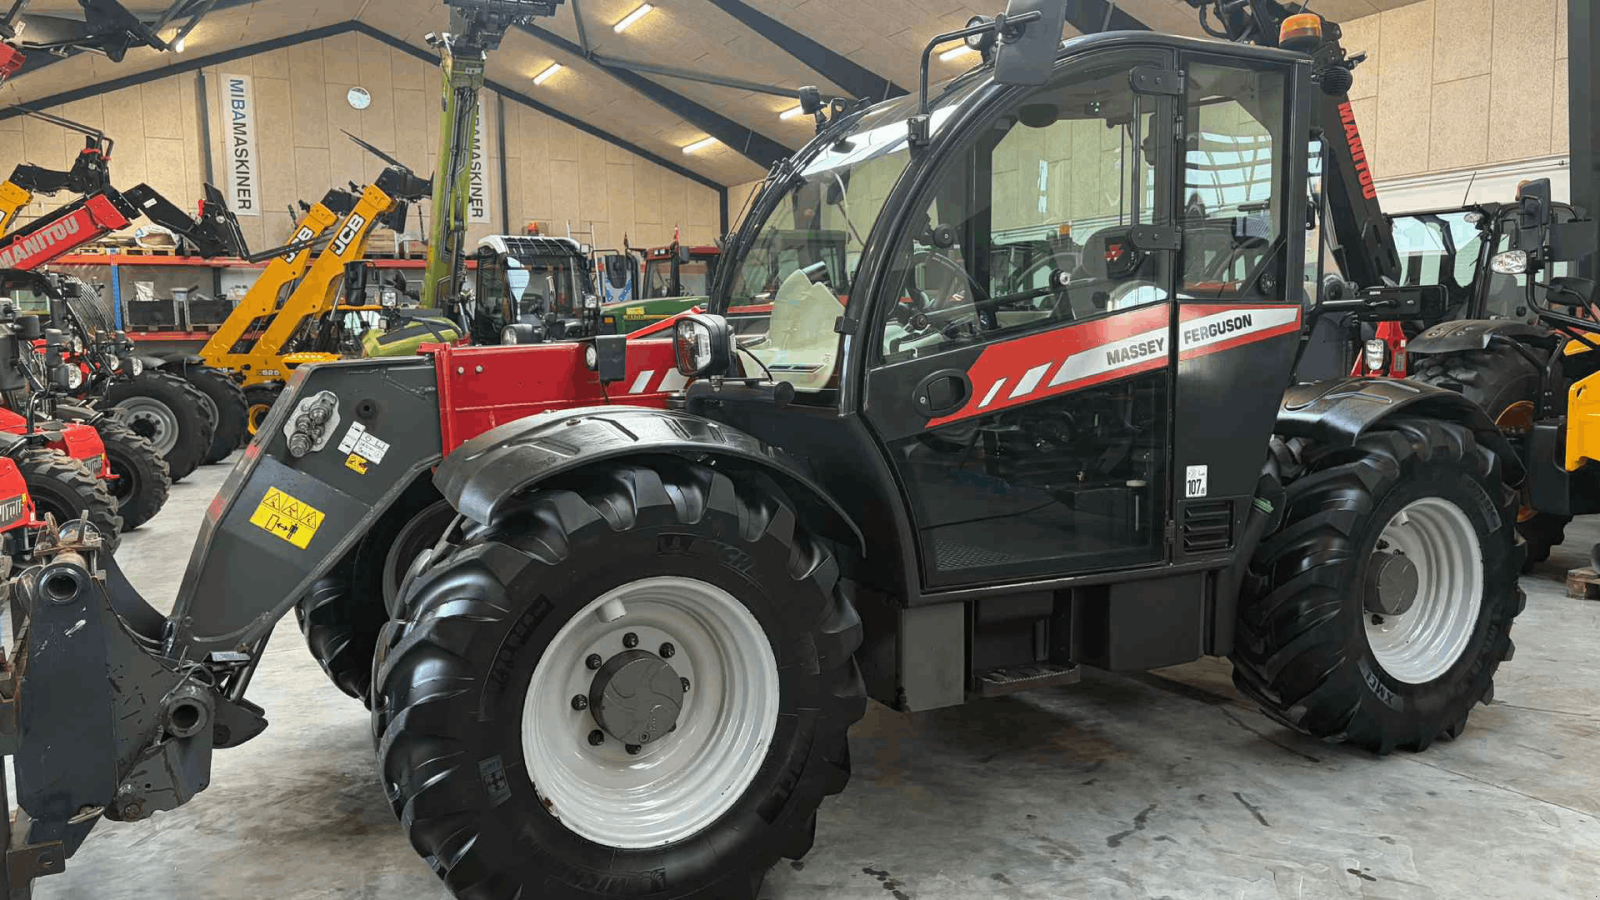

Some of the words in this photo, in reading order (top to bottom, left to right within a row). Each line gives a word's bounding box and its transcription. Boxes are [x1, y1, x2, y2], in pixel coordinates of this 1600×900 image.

[229, 79, 252, 210] MIBAMASKINER
[1337, 101, 1376, 200] MANITOU
[332, 213, 365, 255] JCB
[1106, 337, 1165, 366] MASSEY
[1184, 313, 1253, 345] FERGUSON
[1187, 478, 1202, 496] 107
